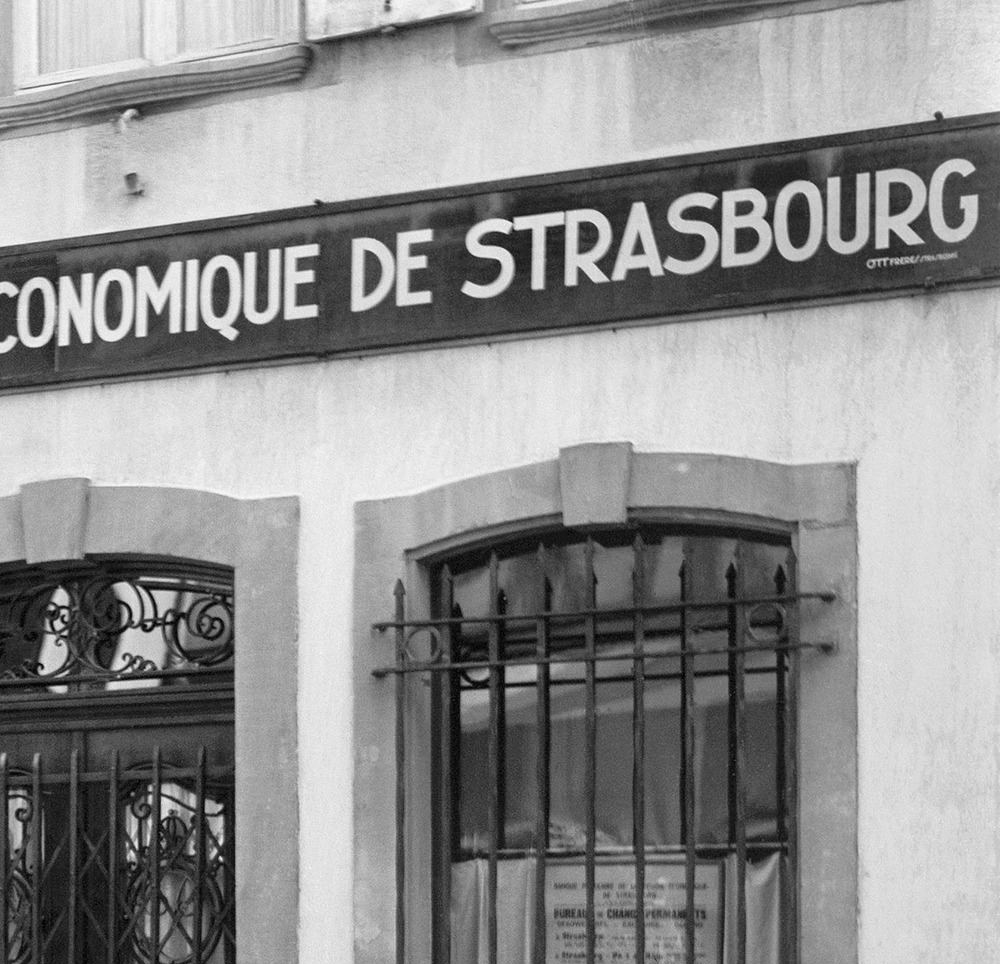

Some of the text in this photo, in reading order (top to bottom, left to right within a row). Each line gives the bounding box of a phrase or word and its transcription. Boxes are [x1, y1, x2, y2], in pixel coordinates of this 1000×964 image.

[350, 228, 434, 313] DE
[460, 158, 979, 299] STRASBOURG
[553, 908, 589, 919] BUREAU
[607, 908, 640, 919] CHANG
[645, 908, 707, 919] PERMANTS
